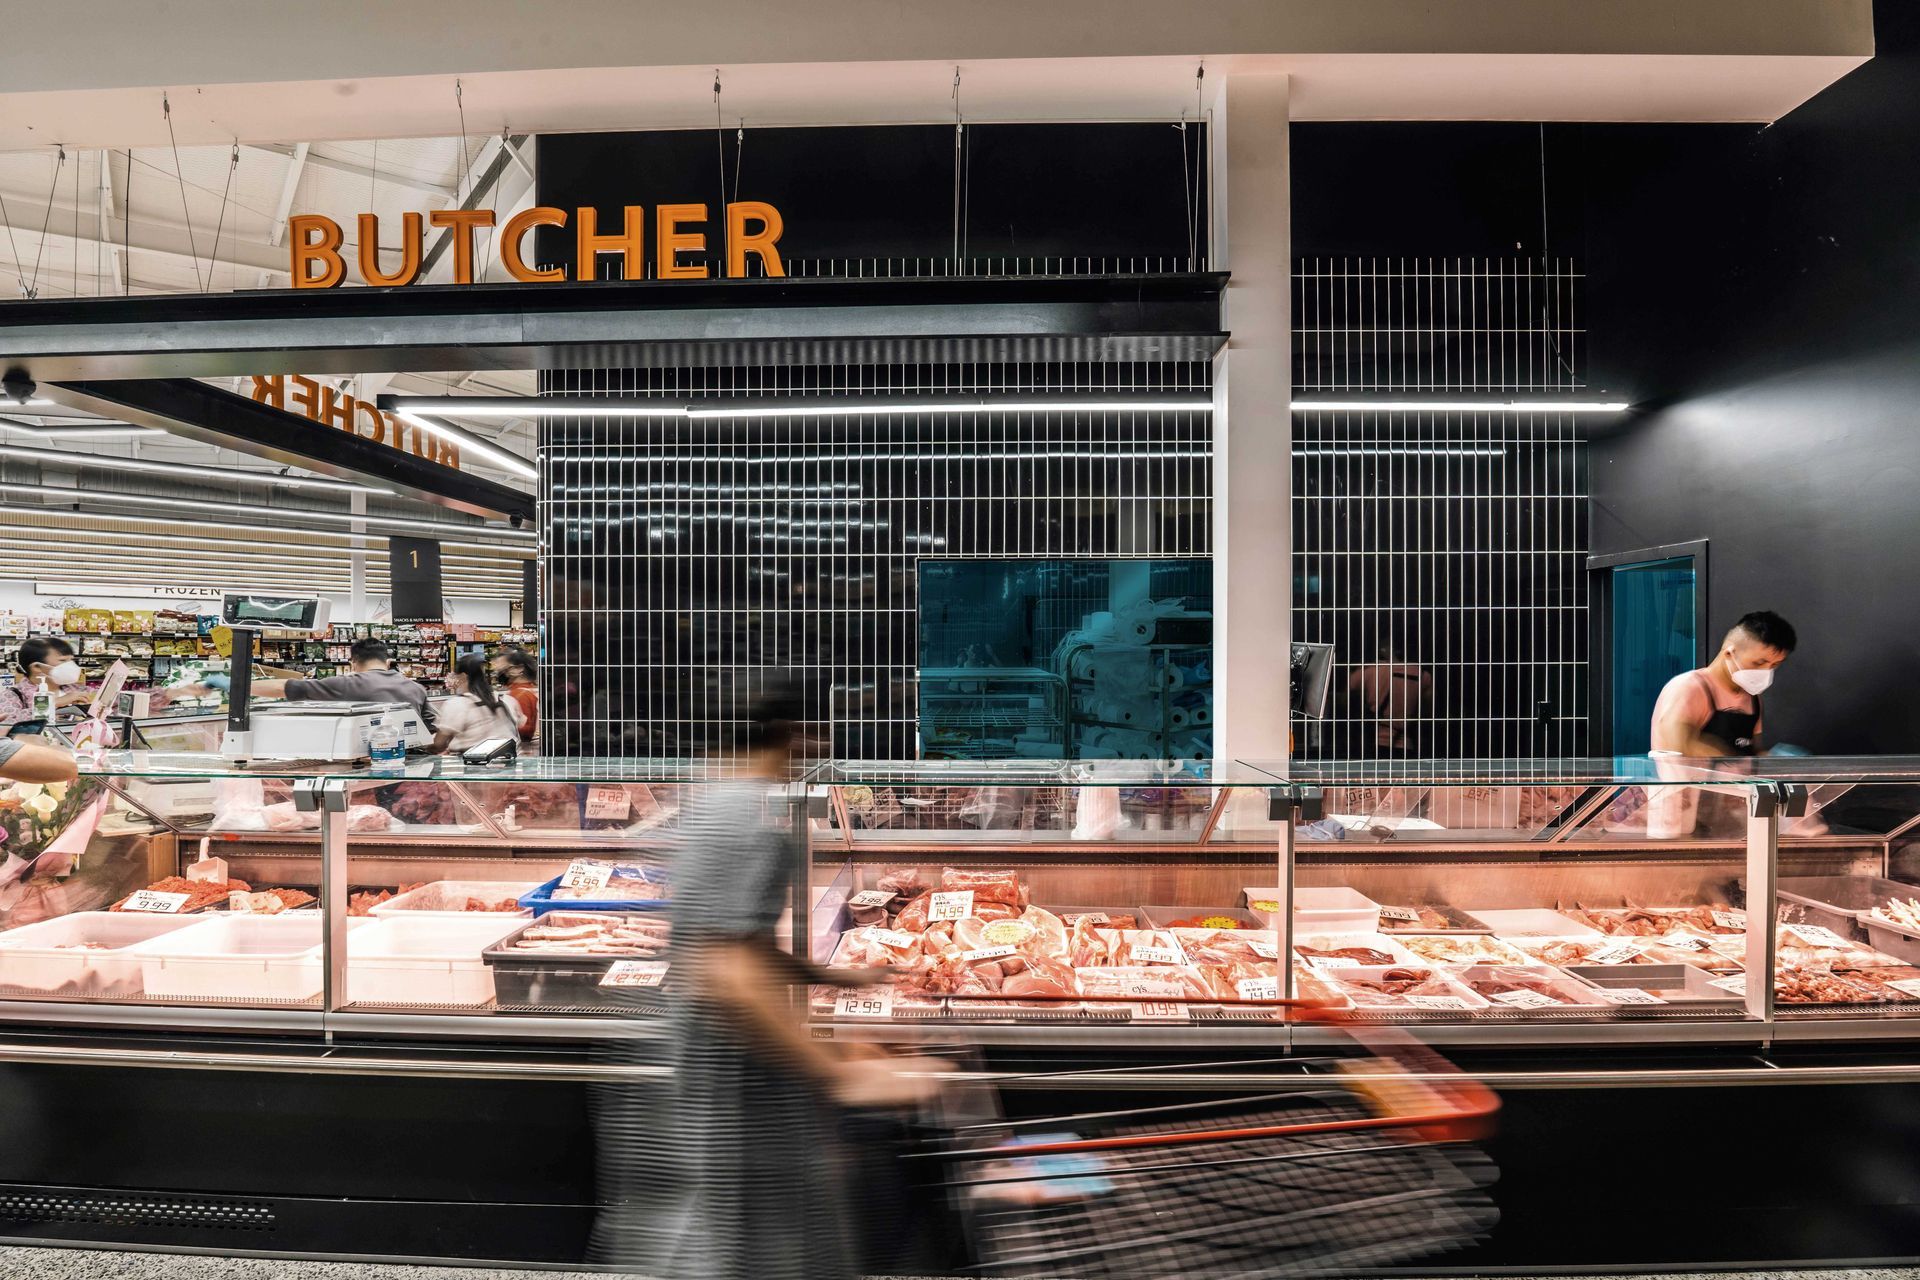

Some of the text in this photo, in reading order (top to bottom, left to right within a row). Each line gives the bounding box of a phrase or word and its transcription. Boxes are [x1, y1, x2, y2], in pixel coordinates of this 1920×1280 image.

[289, 201, 786, 289] BUTCHER
[410, 550, 418, 569] 1
[153, 586, 221, 596] FROZEN
[137, 900, 171, 910] 9.99
[935, 906, 964, 918] 14.99
[844, 1000, 882, 1014] 12.99
[1141, 1001, 1179, 1016] 10.99
